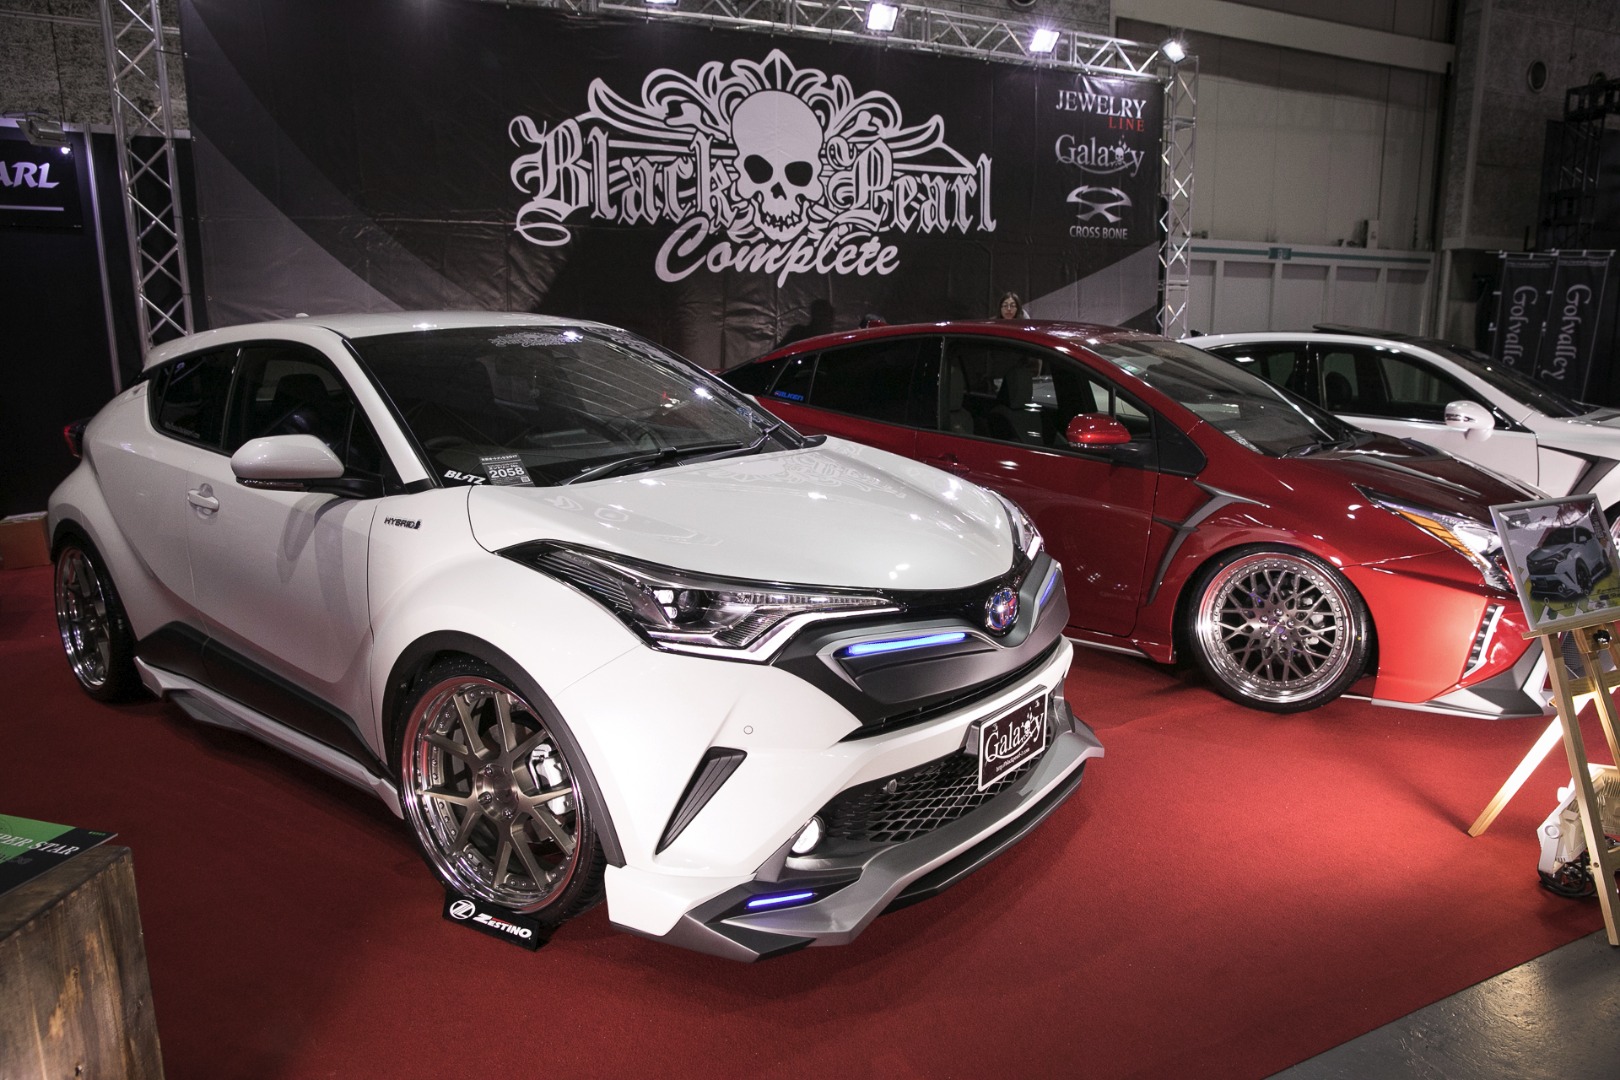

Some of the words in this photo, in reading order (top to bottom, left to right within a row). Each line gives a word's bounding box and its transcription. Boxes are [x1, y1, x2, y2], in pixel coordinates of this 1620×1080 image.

[1056, 90, 1147, 119] JEWELRY
[1108, 117, 1145, 132] LINE
[508, 115, 739, 246] Black
[826, 136, 997, 235] Pearl
[1069, 225, 1100, 238] CROSS
[1102, 227, 1128, 240] BONE
[655, 216, 900, 288] Complete
[1502, 285, 1539, 366] Golvalle
[444, 470, 486, 485] BLITZ
[489, 467, 525, 478] 2058
[384, 516, 416, 529] HYBRID
[28, 841, 79, 856] STAR
[472, 913, 533, 939] ZESTINO
